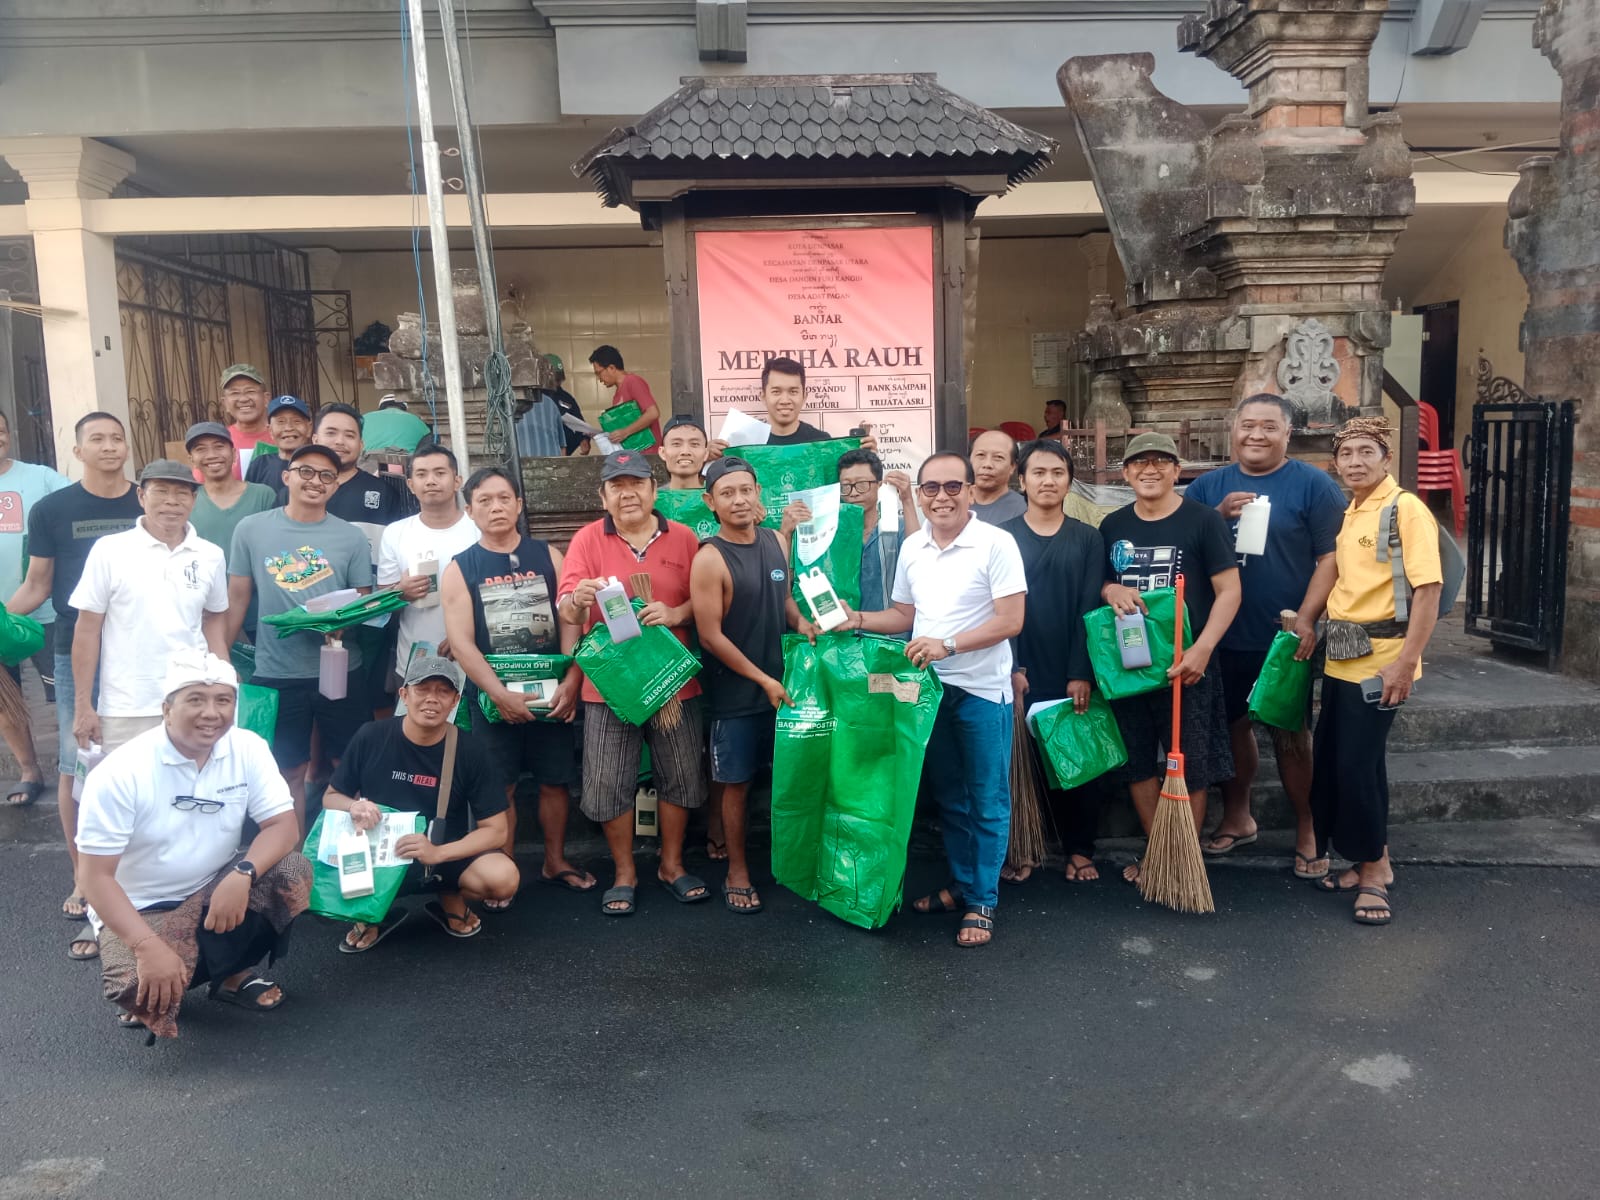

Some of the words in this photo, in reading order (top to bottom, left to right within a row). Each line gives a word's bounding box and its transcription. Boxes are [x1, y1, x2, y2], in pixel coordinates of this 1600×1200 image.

[793, 314, 843, 324] BANJAR
[845, 347, 923, 368] RAUH
[805, 385, 846, 393] OSYANDU
[893, 383, 927, 391] SAMPAH
[713, 395, 761, 403] KELOMPOK
[870, 398, 903, 406] TRIJATA
[805, 401, 839, 409] MEDURI
[490, 661, 532, 669] KOMPOSTE
[533, 661, 550, 669] BAG
[677, 659, 692, 673] BAG
[642, 671, 679, 706] KOMPOSTER
[391, 770, 407, 780] THIS
[407, 774, 414, 782] IS
[416, 776, 433, 785] REAL
